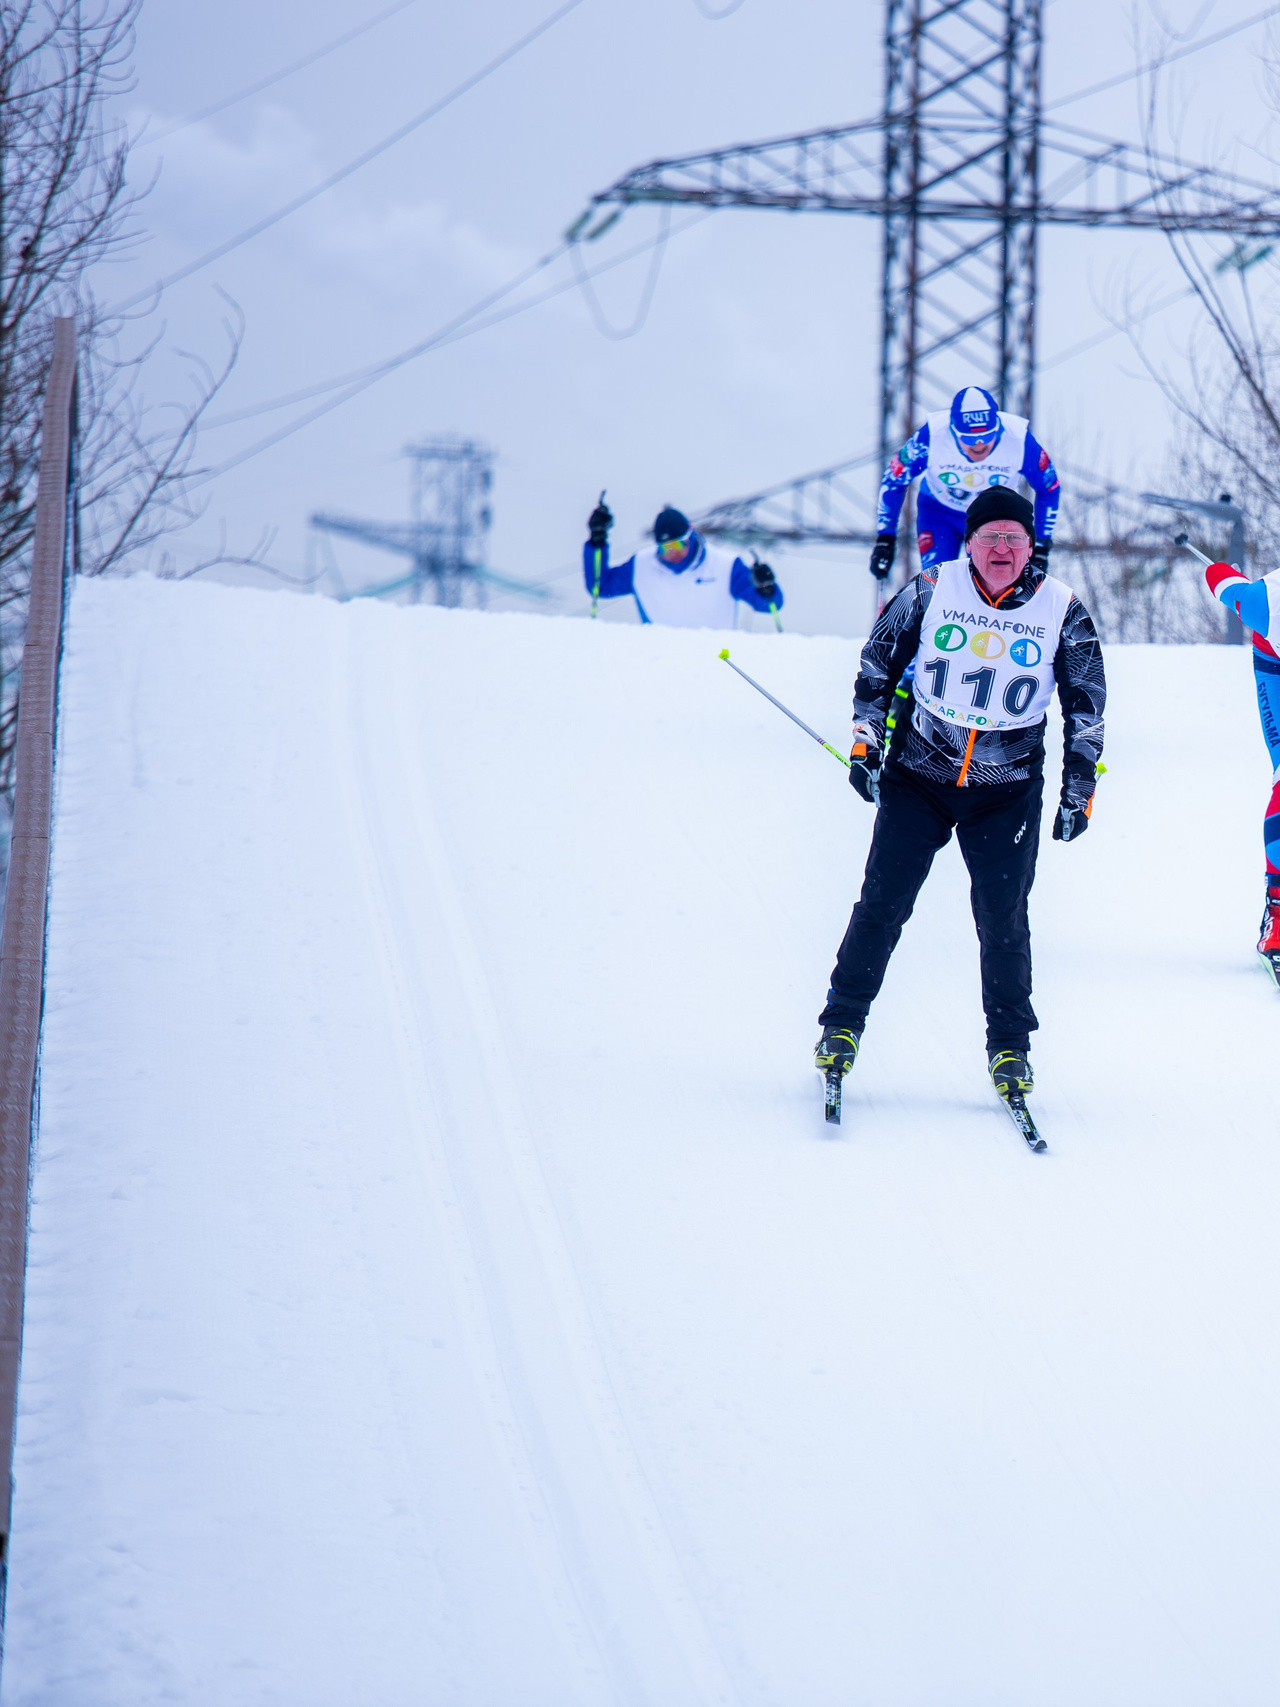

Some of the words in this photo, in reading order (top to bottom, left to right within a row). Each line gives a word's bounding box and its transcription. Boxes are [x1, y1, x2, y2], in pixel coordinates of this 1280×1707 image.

[963, 411, 989, 423] RWT
[943, 609, 1045, 638] VMARAFONE
[924, 656, 1040, 717] 110
[1258, 681, 1280, 748] БУГУЛЬМА
